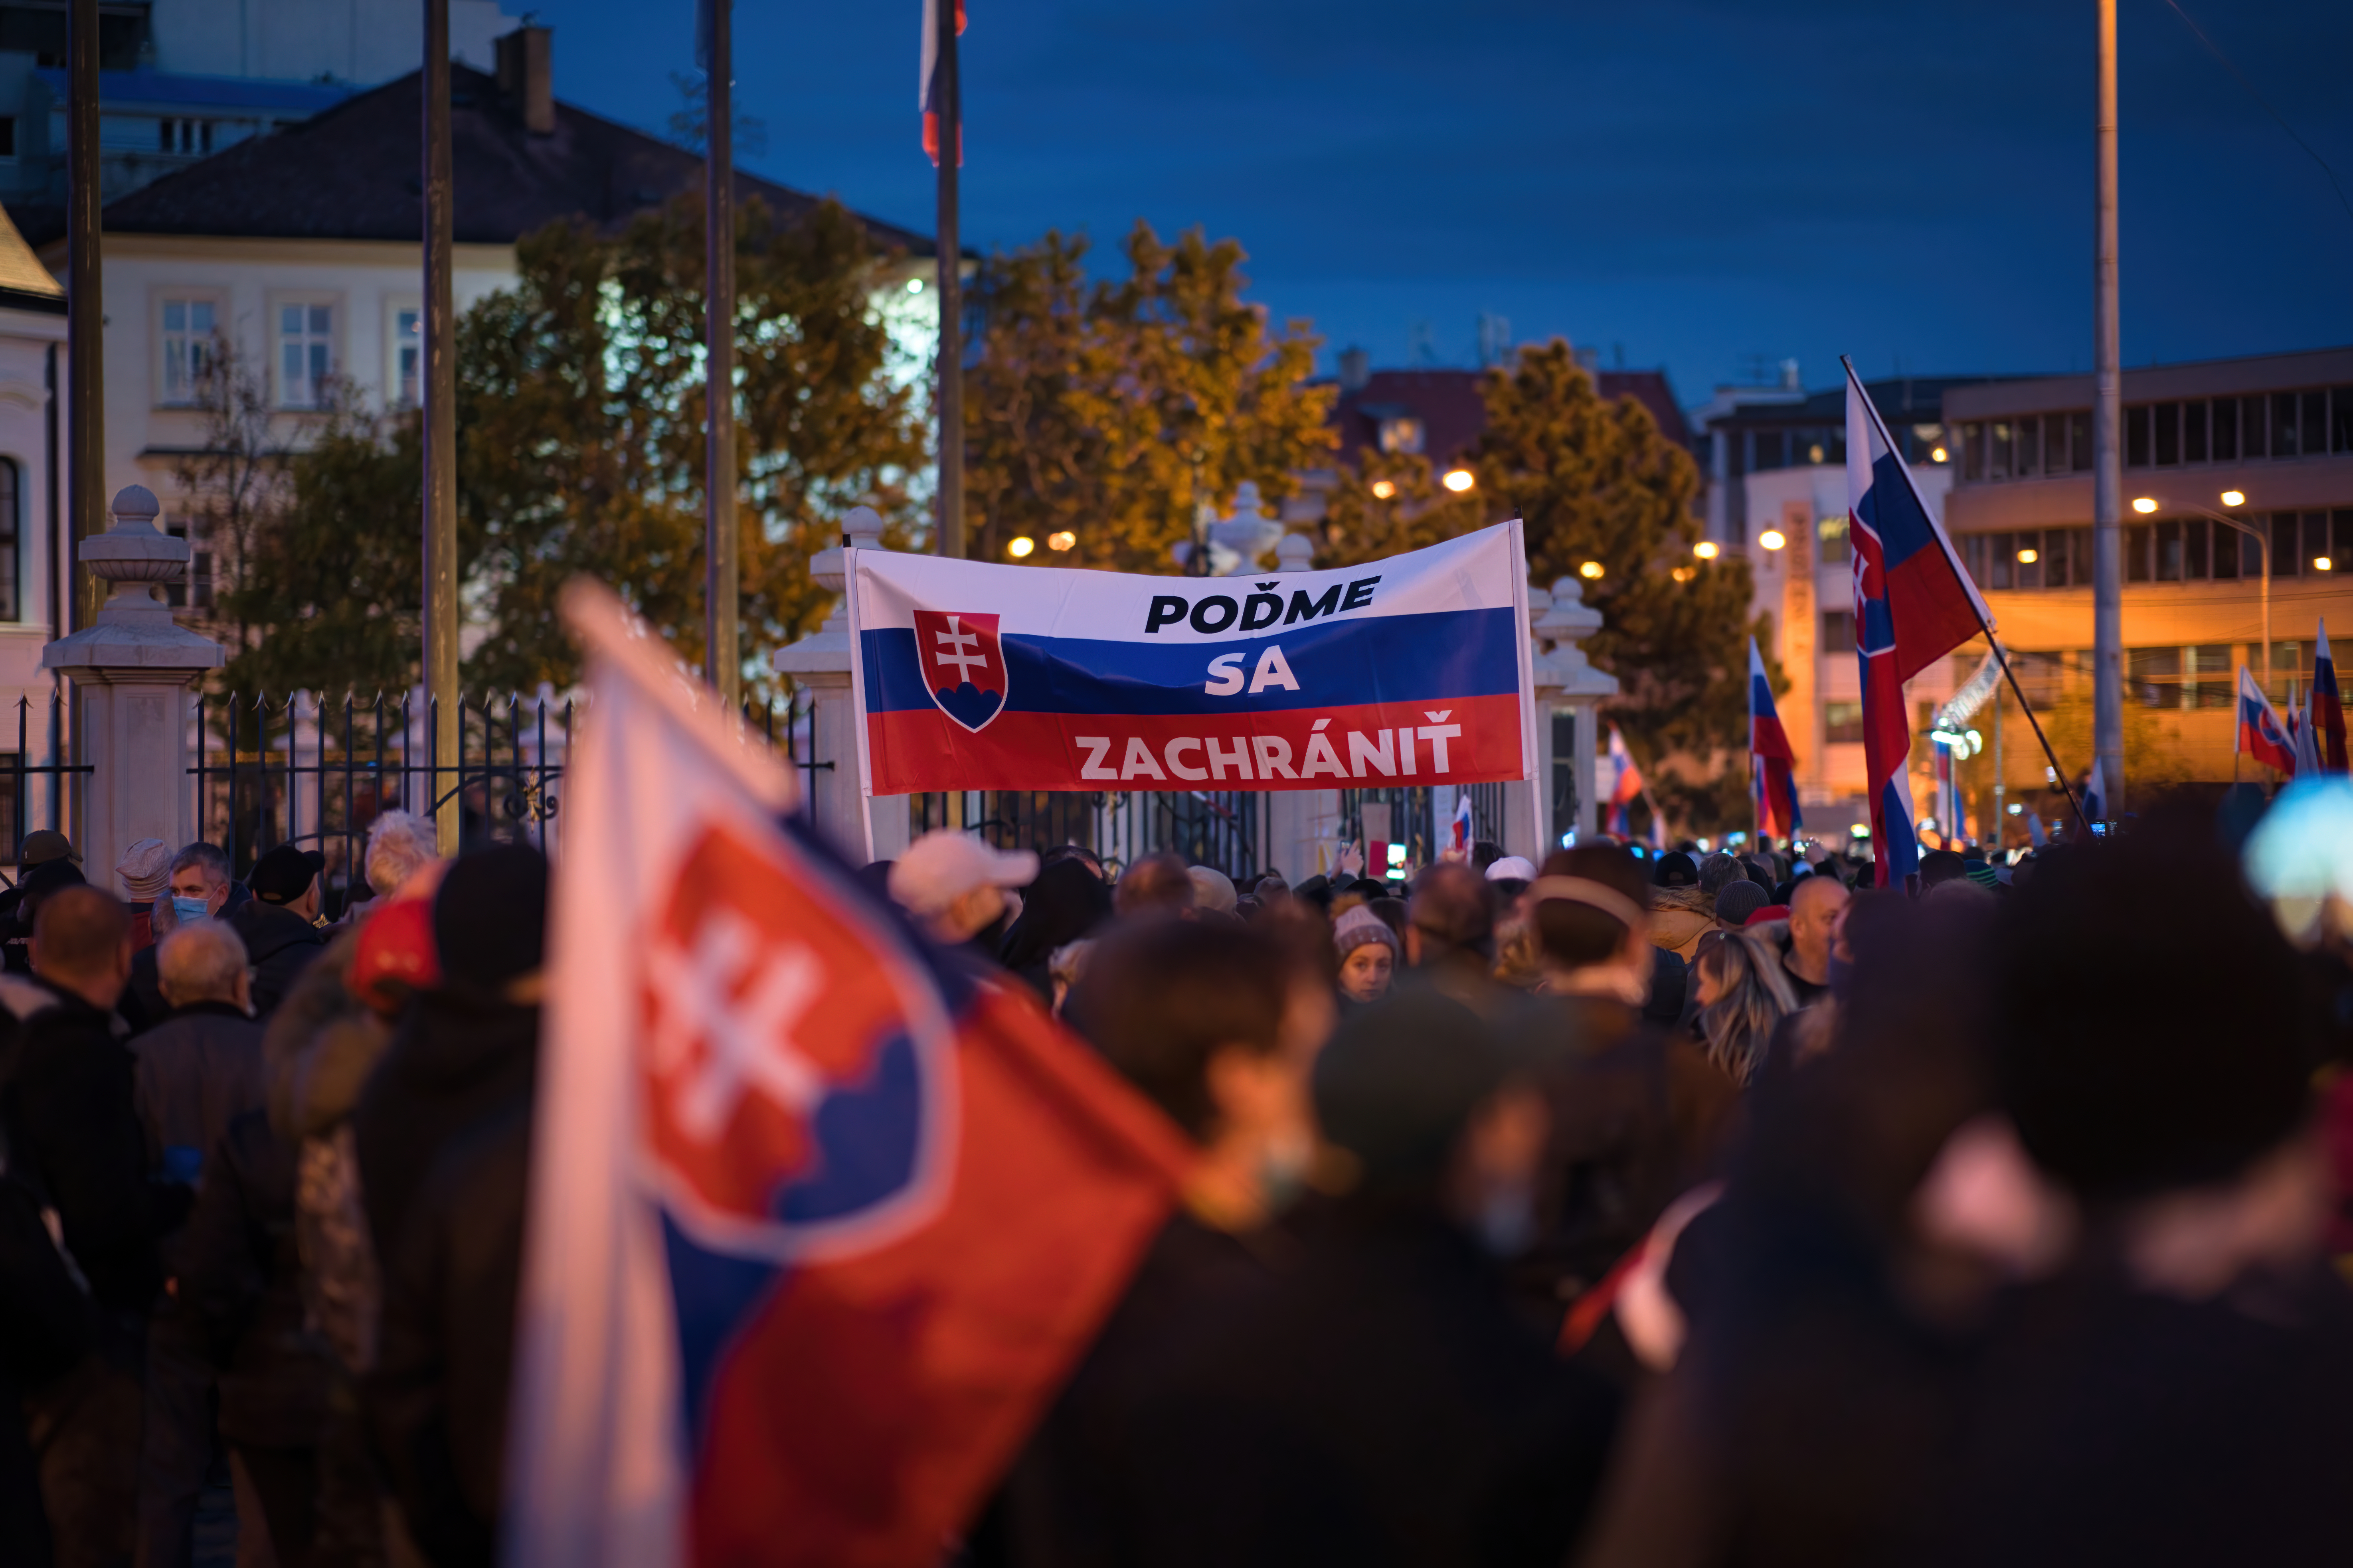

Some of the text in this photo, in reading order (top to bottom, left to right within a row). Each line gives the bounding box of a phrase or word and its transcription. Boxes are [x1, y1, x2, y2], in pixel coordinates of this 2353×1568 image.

[1144, 575, 1382, 634] POĎME
[1204, 644, 1301, 696] SA
[1075, 709, 1461, 781] ZACHRÁNIŤ
